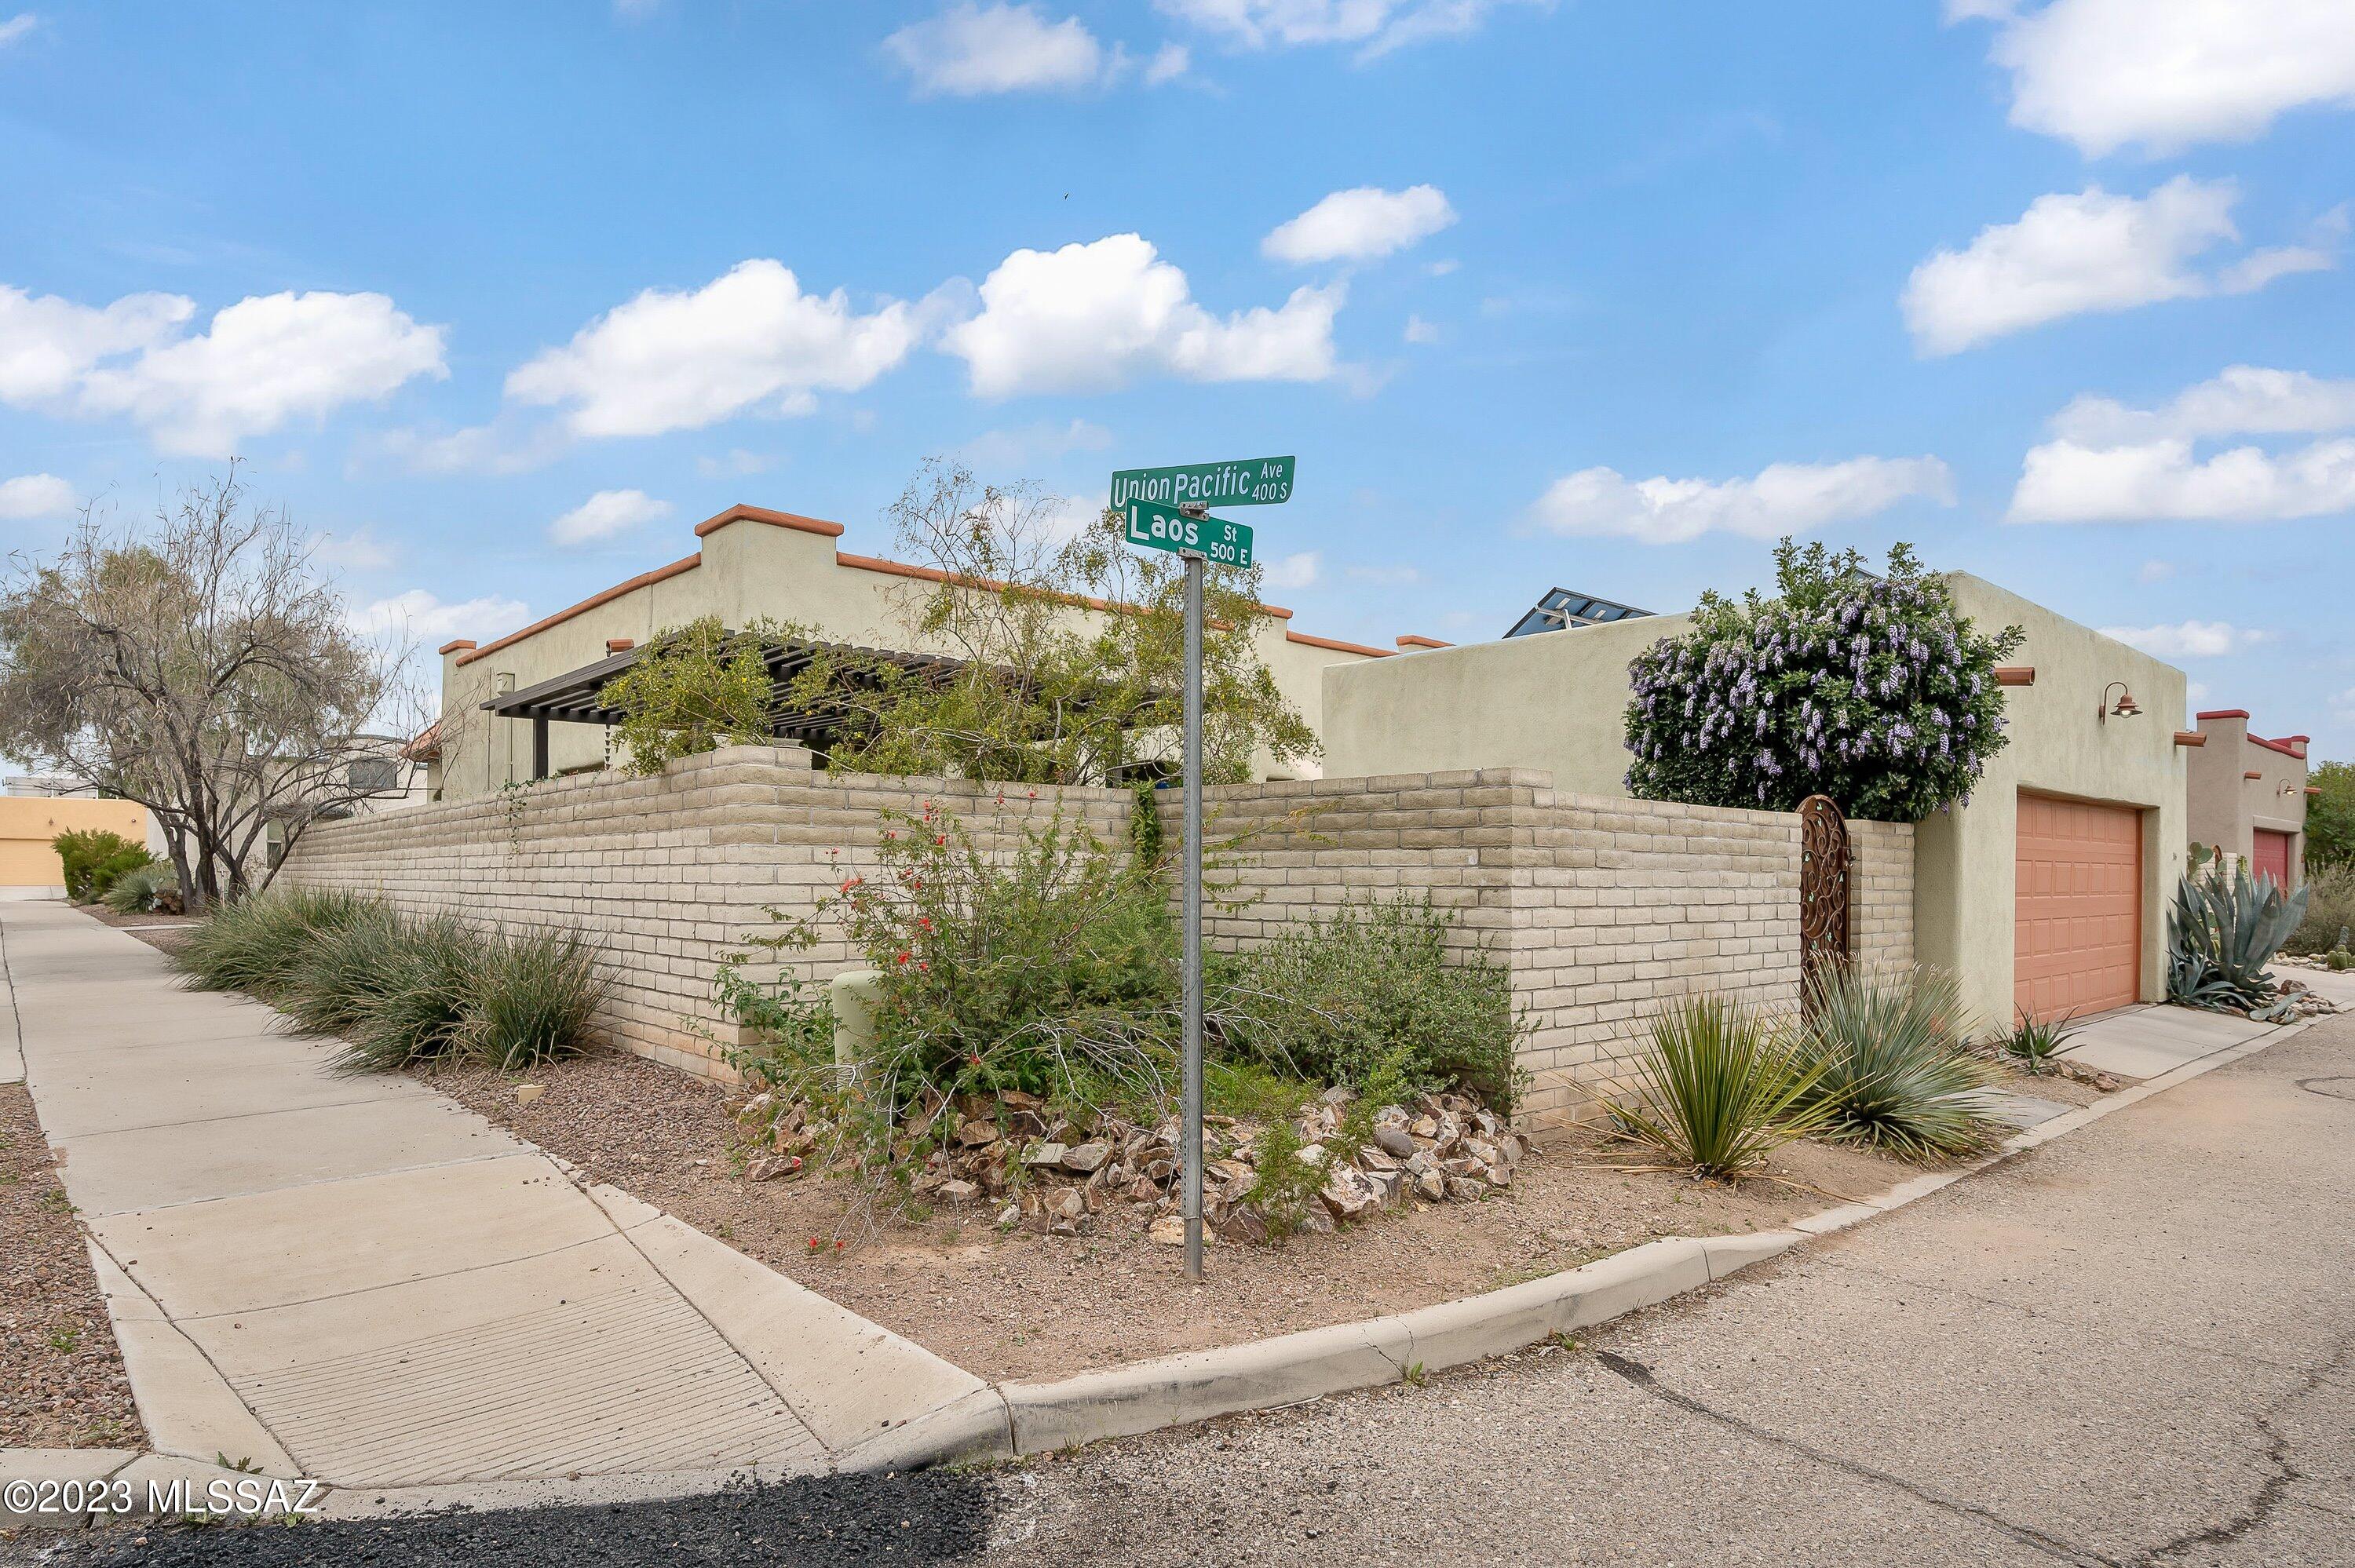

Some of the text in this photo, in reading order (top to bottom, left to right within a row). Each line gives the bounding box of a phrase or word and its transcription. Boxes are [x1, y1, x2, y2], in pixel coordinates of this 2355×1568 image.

[1260, 462, 1283, 480] Ave
[1114, 465, 1251, 508] Union Pacific
[1251, 482, 1287, 501] 400 S
[1130, 505, 1199, 545] Laos
[1224, 524, 1237, 543] St
[1210, 542, 1247, 565] 500 E
